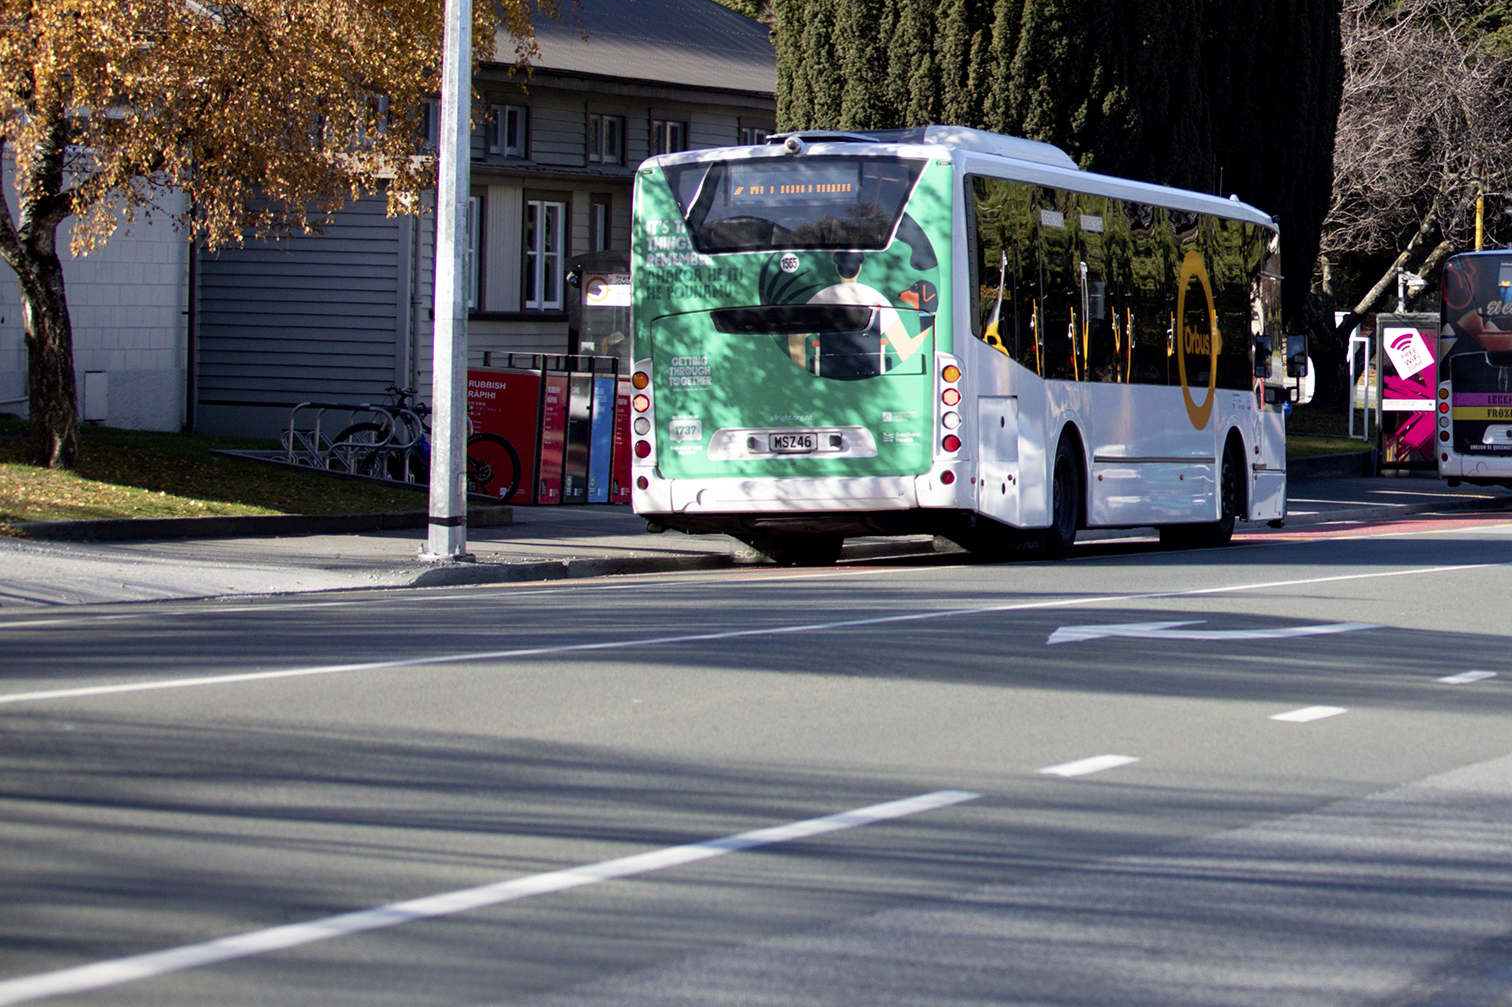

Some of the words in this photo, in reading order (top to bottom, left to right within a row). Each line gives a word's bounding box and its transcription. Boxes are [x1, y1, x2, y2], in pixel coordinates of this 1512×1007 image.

[646, 220, 670, 235] IT'S
[781, 257, 797, 269] 1565
[647, 268, 703, 284] AHAKOA
[707, 268, 722, 282] HE
[646, 285, 662, 300] HE
[667, 284, 732, 298] POUNAMU
[1487, 300, 1503, 315] El
[1184, 325, 1210, 355] Orbus
[1401, 347, 1417, 359] FREE
[671, 356, 708, 366] GETTING
[669, 366, 711, 376] THROUGH
[468, 380, 506, 390] RUBBISH
[668, 376, 712, 386] TOGETHER
[674, 426, 697, 435] 1737
[774, 436, 812, 448] MSZ46
